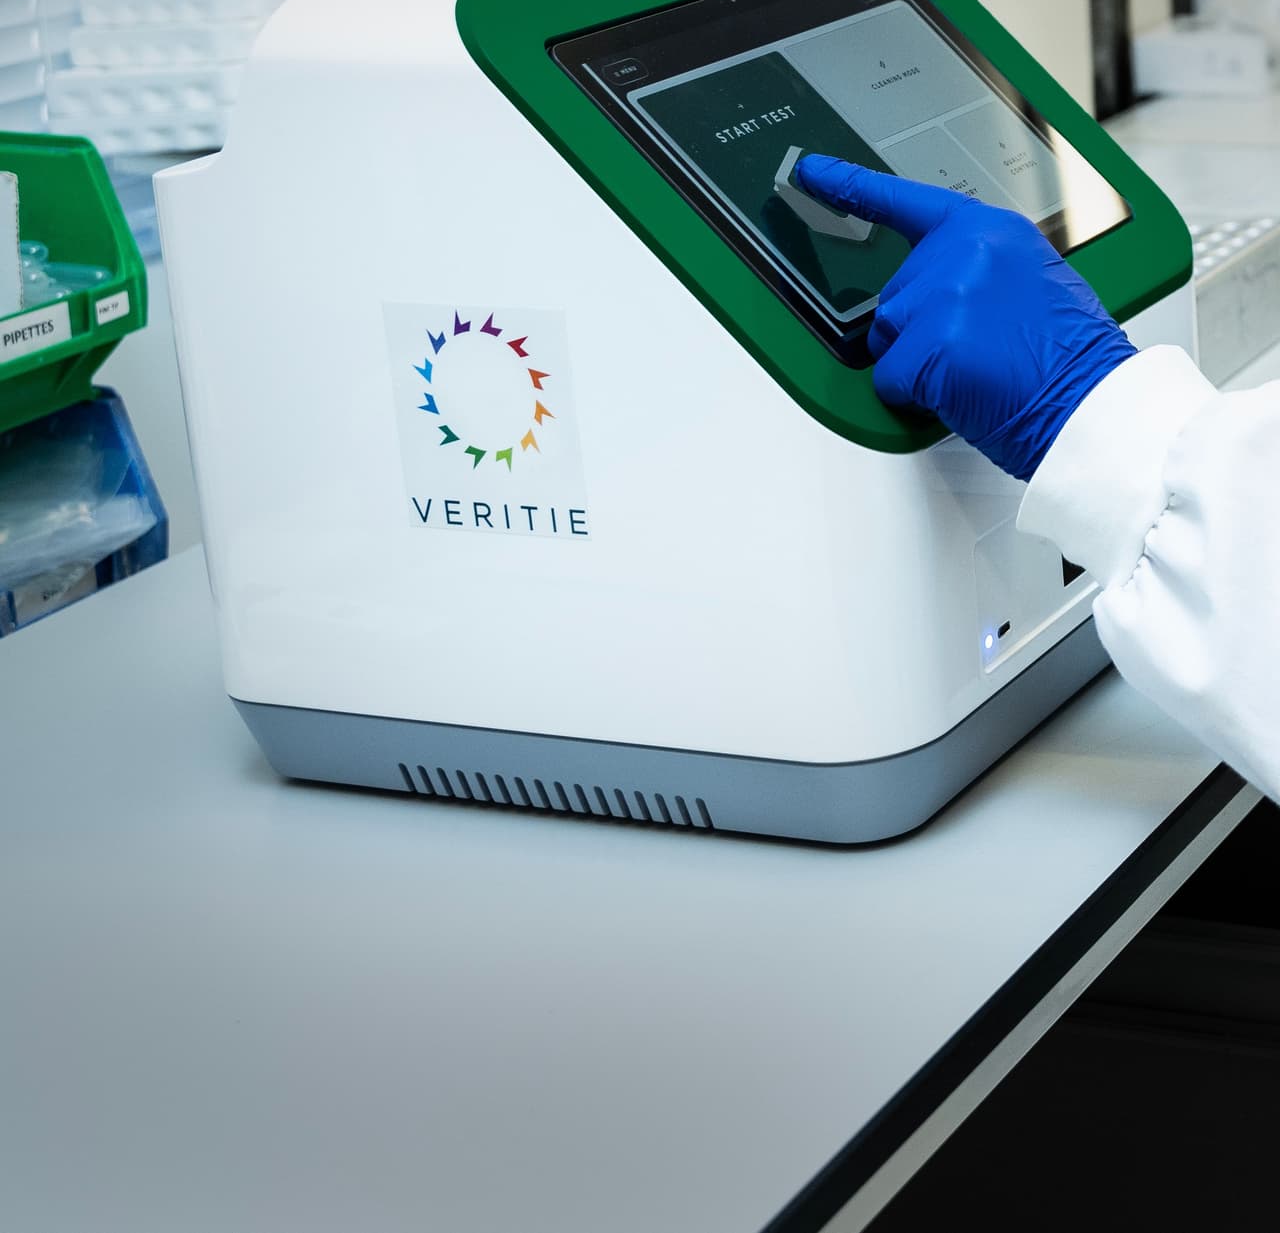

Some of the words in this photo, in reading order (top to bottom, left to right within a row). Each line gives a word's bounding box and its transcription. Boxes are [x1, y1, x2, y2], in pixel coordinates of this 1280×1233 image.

[871, 74, 902, 90] CLEANING
[902, 67, 920, 77] MODE
[715, 119, 760, 143] START
[760, 105, 796, 125] TEST
[3, 319, 55, 346] PIPETTES
[412, 497, 589, 535] VERITIE
